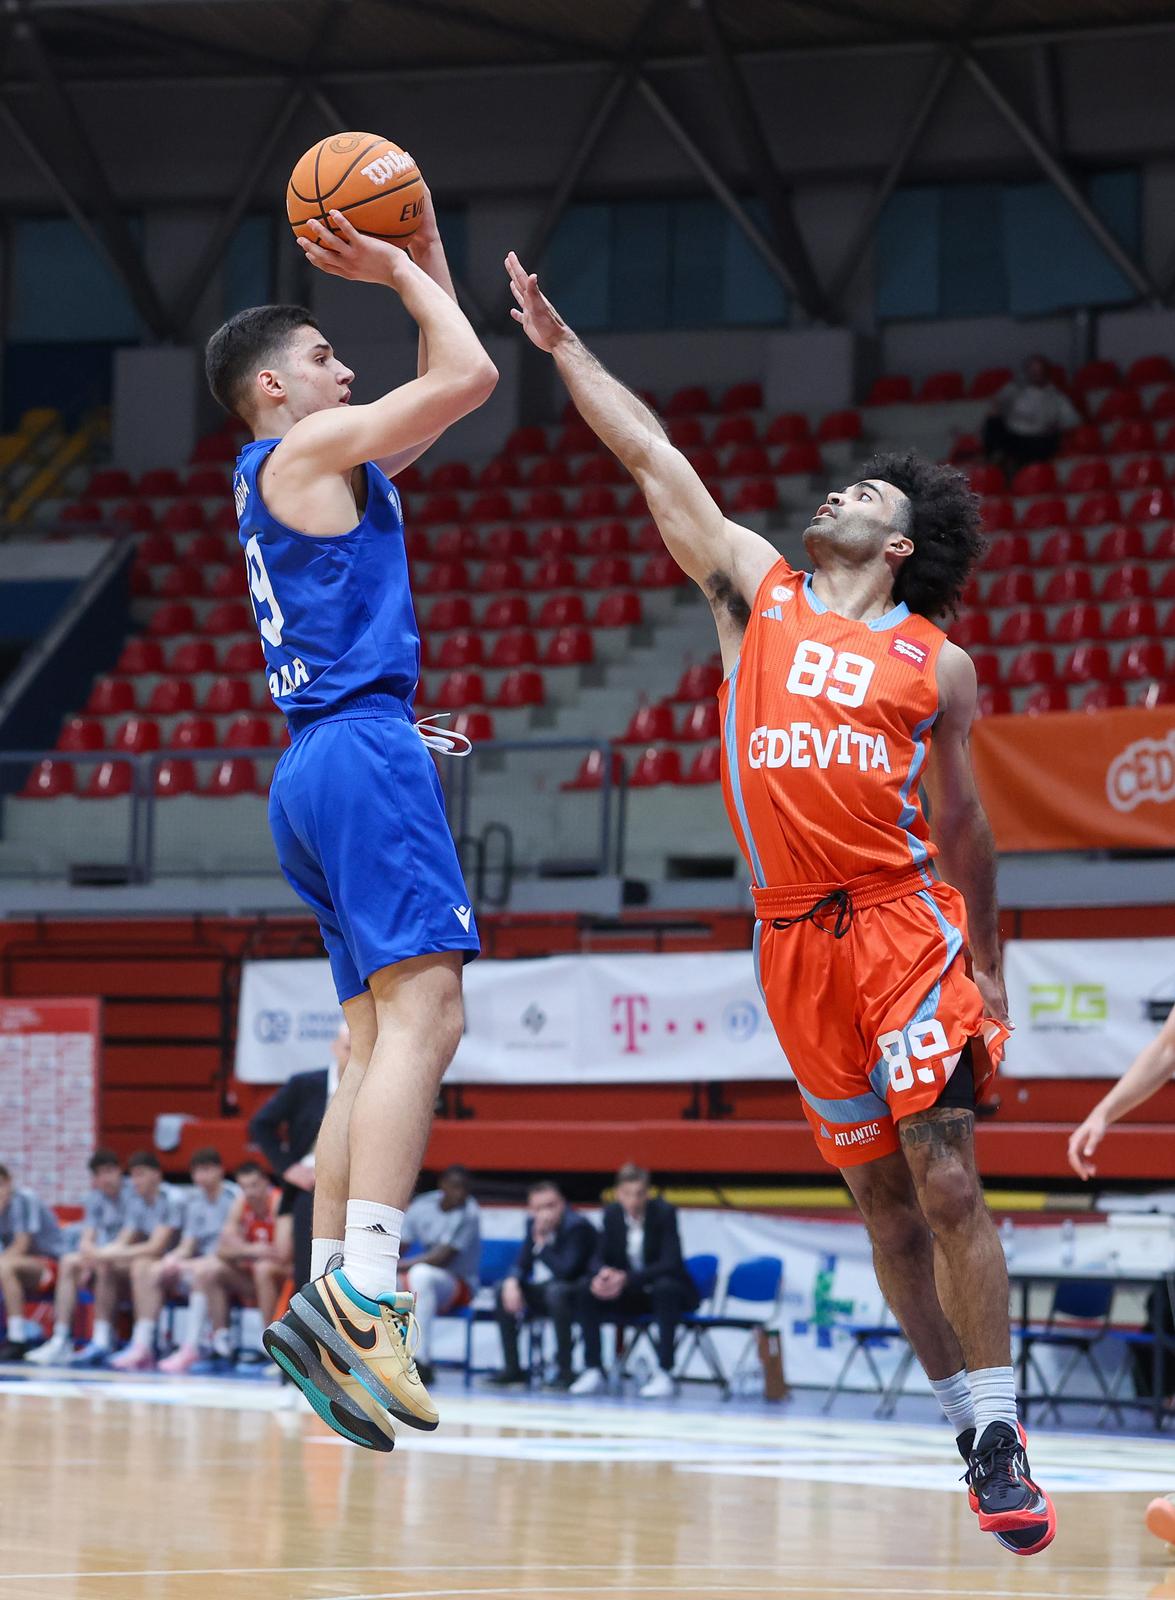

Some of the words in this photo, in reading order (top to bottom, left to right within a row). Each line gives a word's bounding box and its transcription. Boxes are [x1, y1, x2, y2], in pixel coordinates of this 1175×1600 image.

[786, 639, 876, 708] 89
[1028, 983, 1107, 1022] PG
[877, 1018, 962, 1092] 89
[834, 1122, 881, 1146] ATLANTIC
